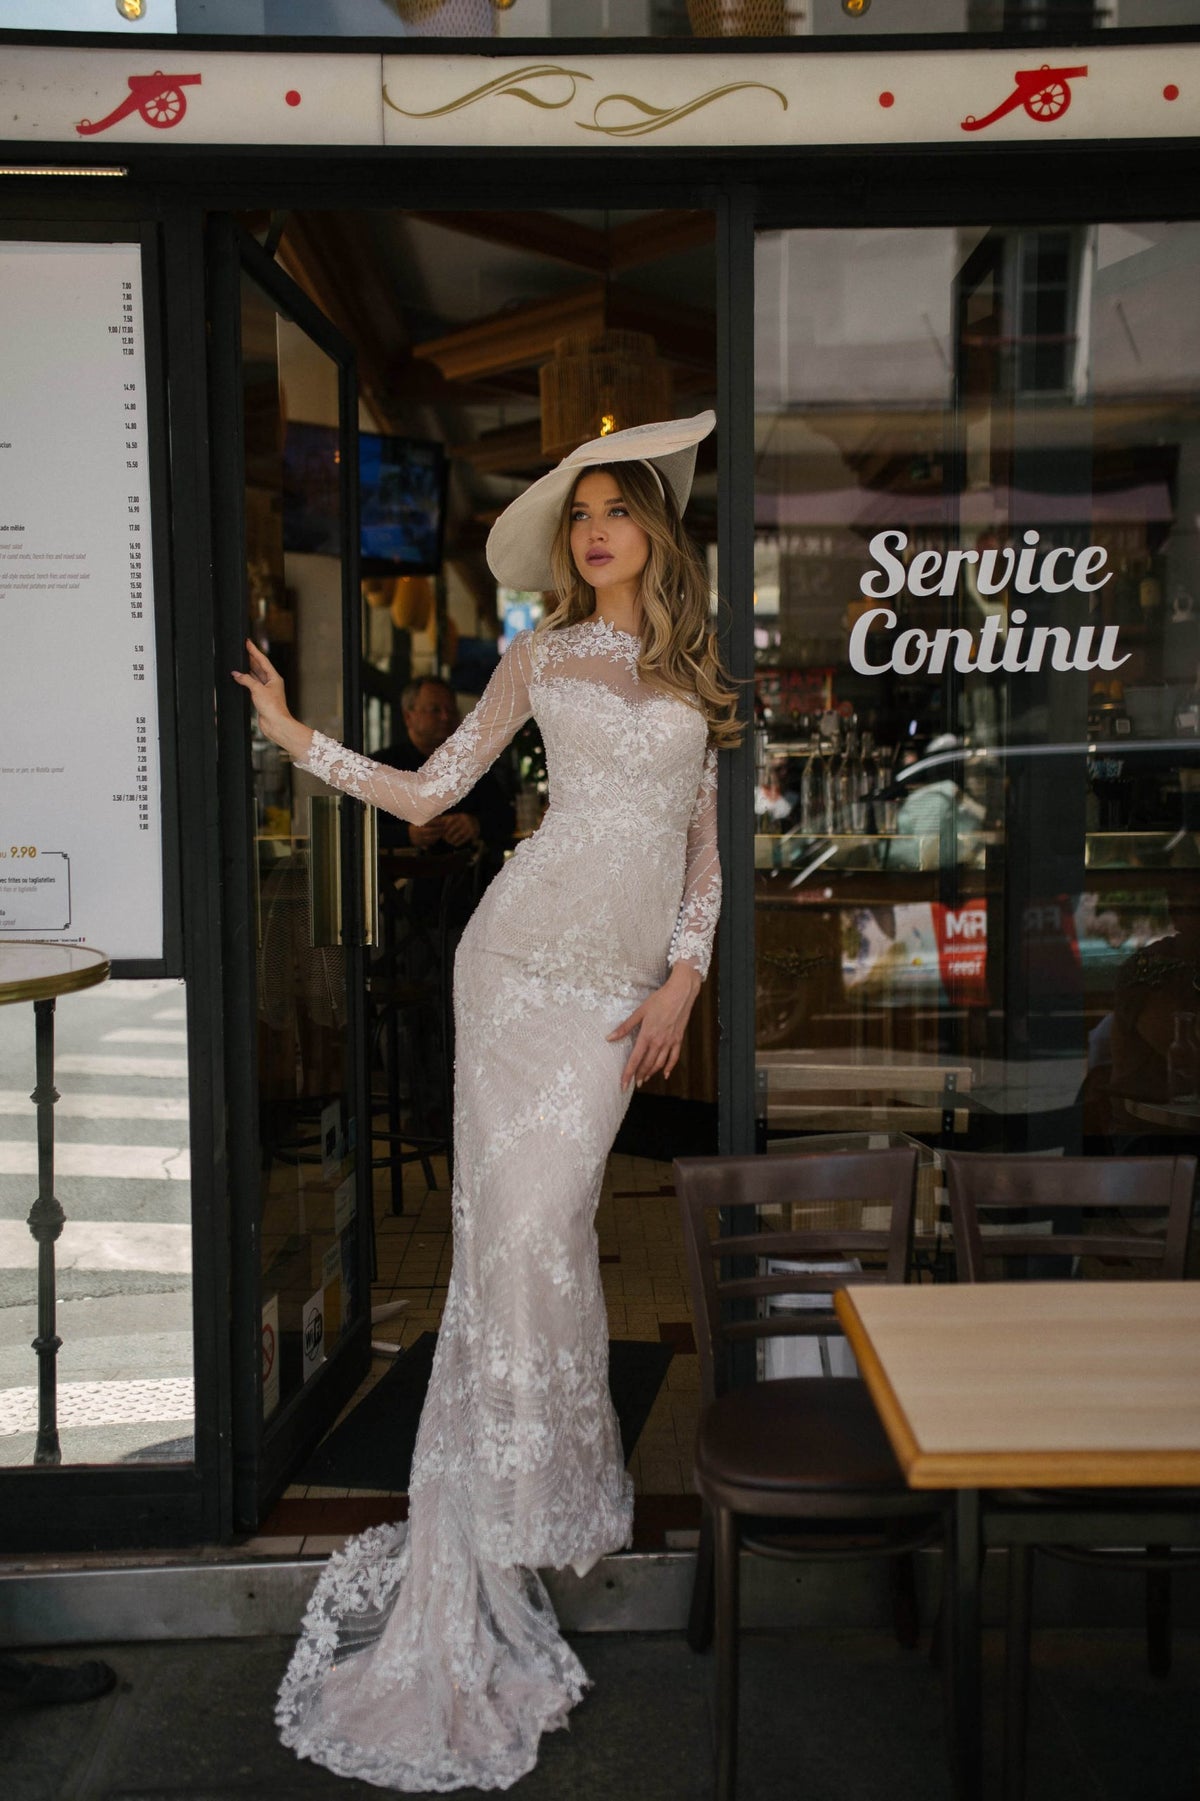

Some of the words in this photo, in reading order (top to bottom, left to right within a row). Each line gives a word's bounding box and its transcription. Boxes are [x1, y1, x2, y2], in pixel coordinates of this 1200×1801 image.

[860, 531, 1113, 597] Service
[850, 607, 1131, 675] Continu
[10, 846, 37, 859] 9.90
